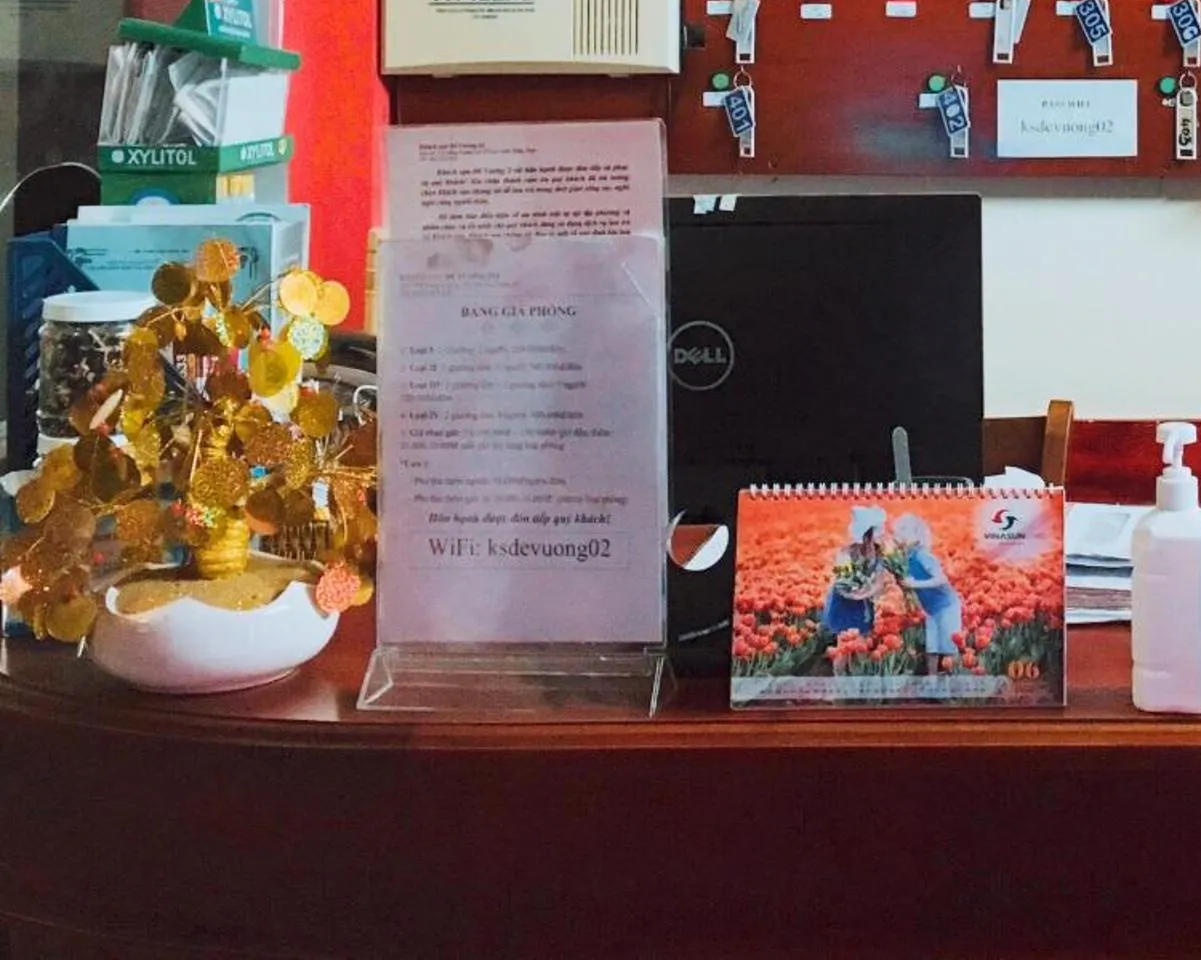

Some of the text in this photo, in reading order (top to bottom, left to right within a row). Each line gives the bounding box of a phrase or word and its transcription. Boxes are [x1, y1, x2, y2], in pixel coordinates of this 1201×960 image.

[223, 5, 253, 28] XYLITOL
[1078, 3, 1106, 41] 305
[729, 96, 750, 133] 401
[127, 149, 197, 165] XYLITOL
[245, 142, 275, 158] XYLITOL
[674, 346, 727, 364] DELL
[984, 532, 1026, 540] VINASUN
[428, 537, 611, 562] WiFi: ksdevuong02
[1008, 660, 1040, 680] 06
